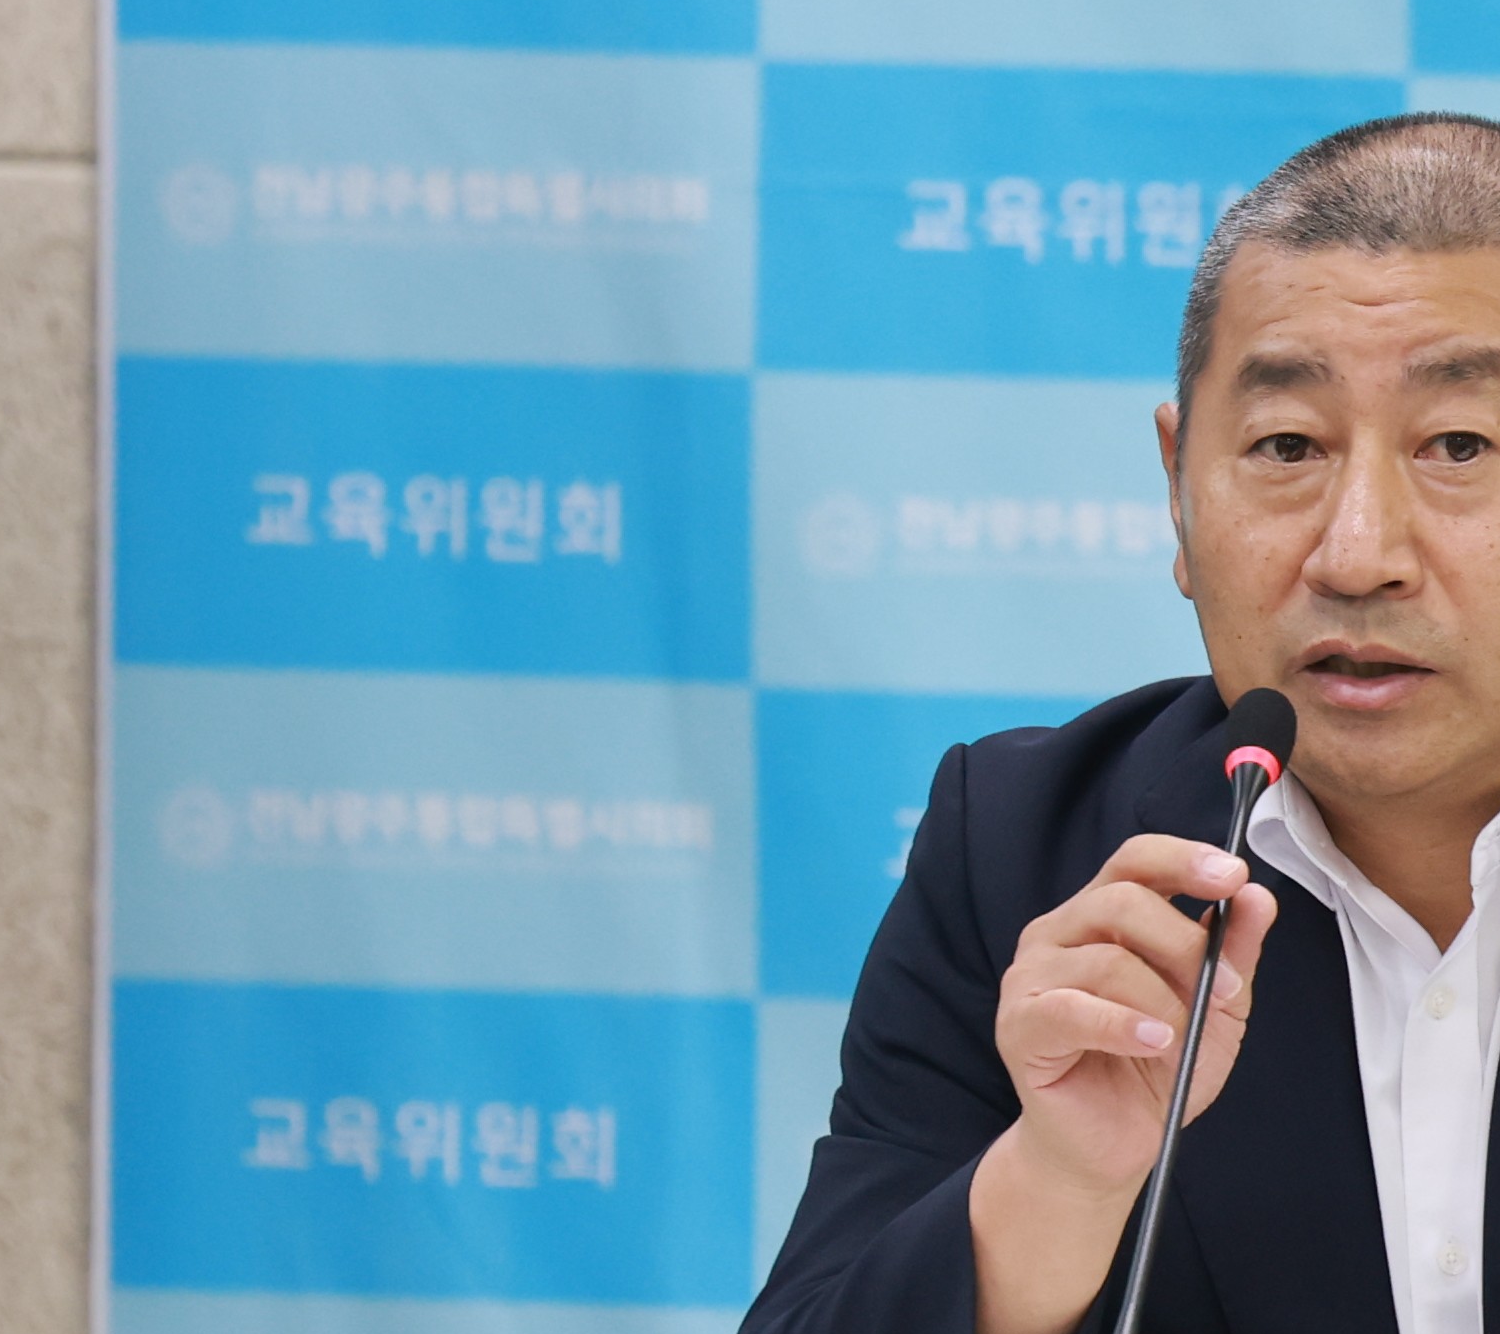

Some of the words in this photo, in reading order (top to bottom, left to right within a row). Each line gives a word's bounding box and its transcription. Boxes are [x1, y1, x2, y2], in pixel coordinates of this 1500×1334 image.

[898, 175, 1250, 268] 교육위원
[247, 469, 626, 566] 교육위원회
[244, 1096, 620, 1191] 교육위원회
